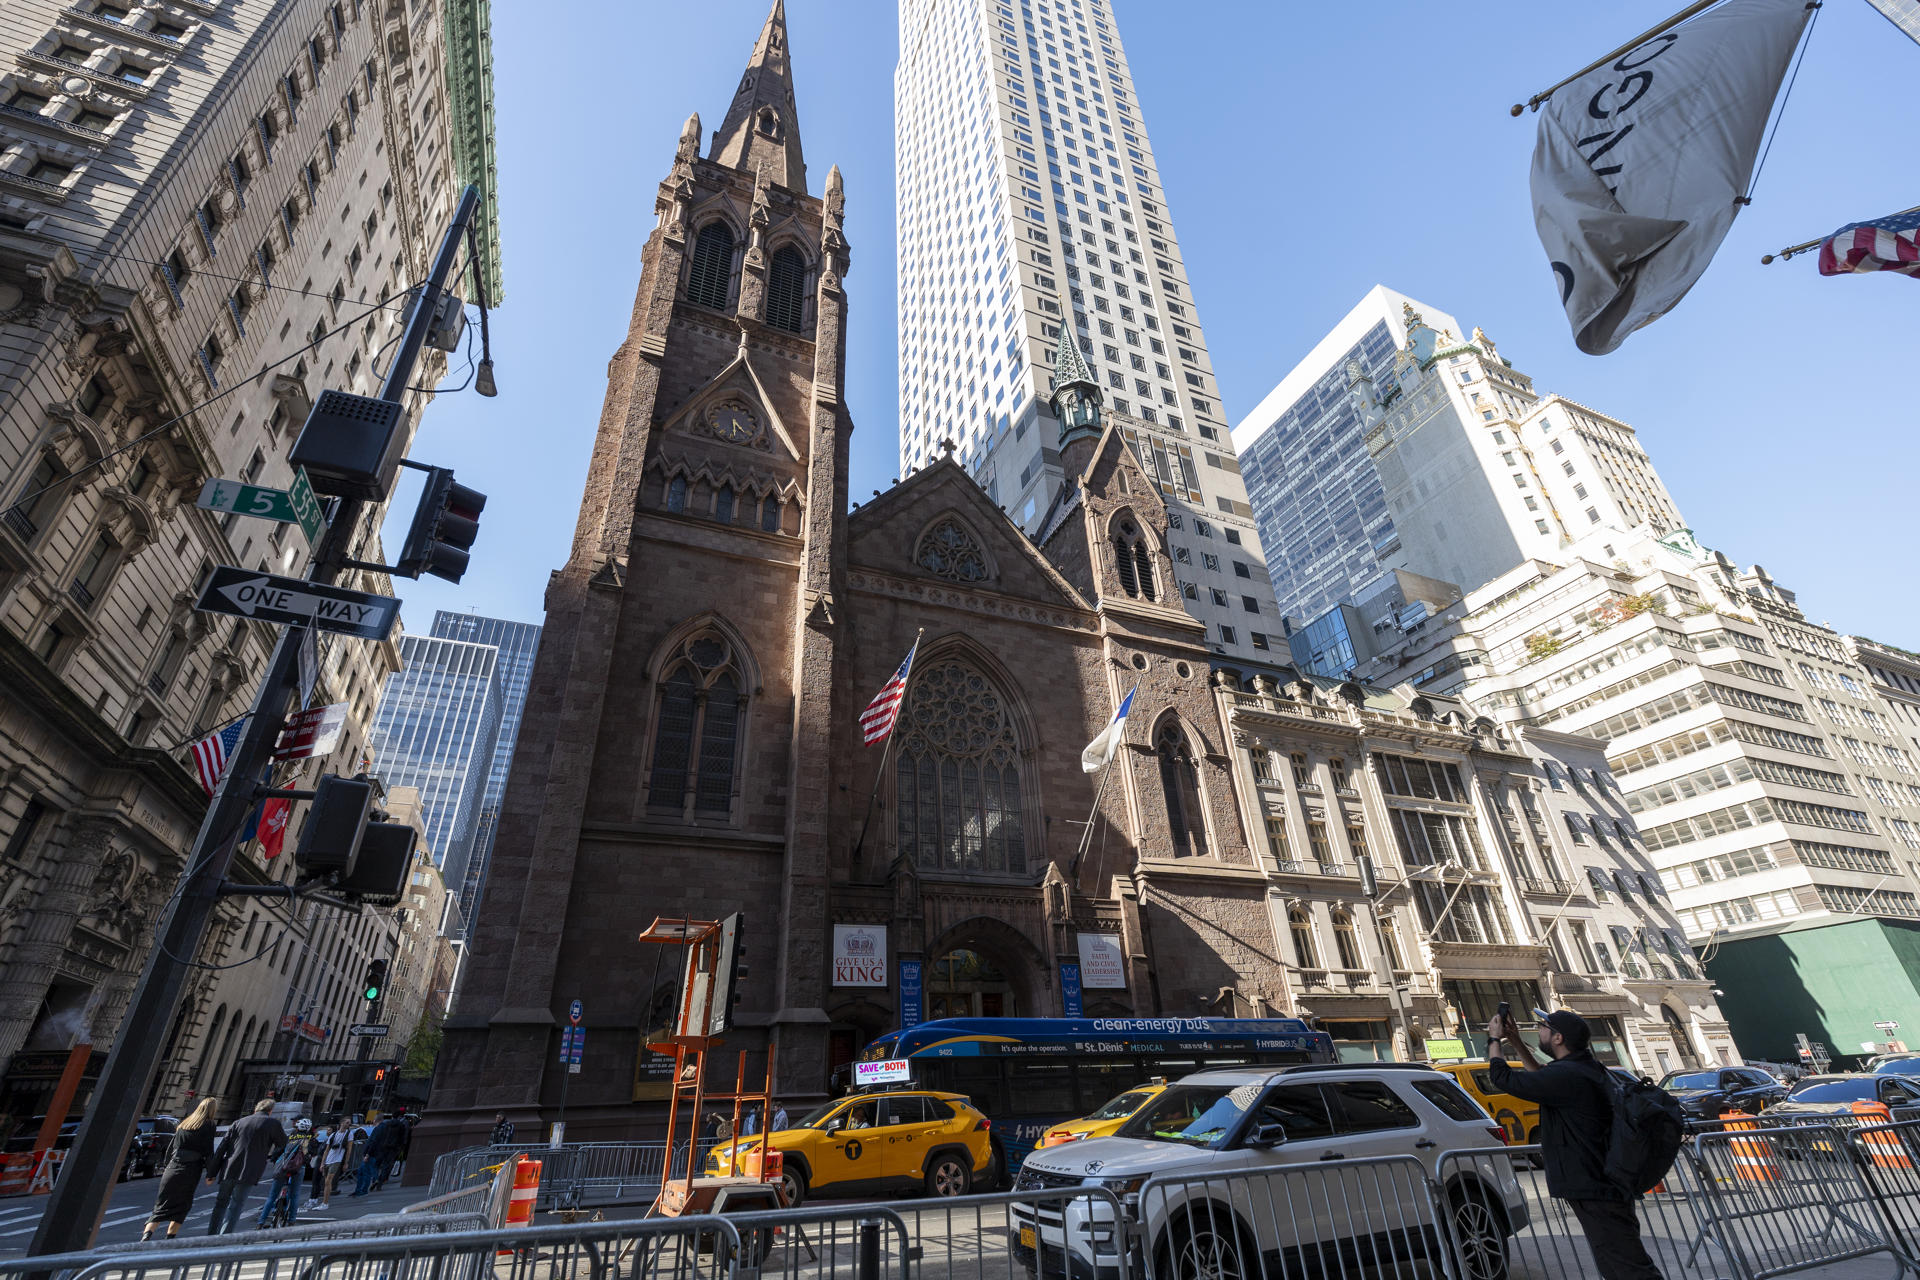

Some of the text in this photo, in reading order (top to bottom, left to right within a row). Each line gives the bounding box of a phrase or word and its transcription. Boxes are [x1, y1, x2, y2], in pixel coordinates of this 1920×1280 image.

[249, 490, 277, 514] 5
[297, 487, 313, 520] 55
[311, 509, 320, 527] ST
[237, 584, 374, 623] ONE WAY
[140, 809, 177, 843] PENINSULA
[835, 957, 885, 967] GIVE US A
[836, 966, 883, 982] KING
[1093, 1018, 1210, 1033] clean-energy bus
[1012, 1045, 1027, 1053] quite
[1085, 1042, 1098, 1052] St.
[1130, 1044, 1166, 1052] MEDICAL
[858, 1063, 880, 1074] SAVE
[884, 1061, 906, 1071] BOTH
[848, 1143, 859, 1158] T
